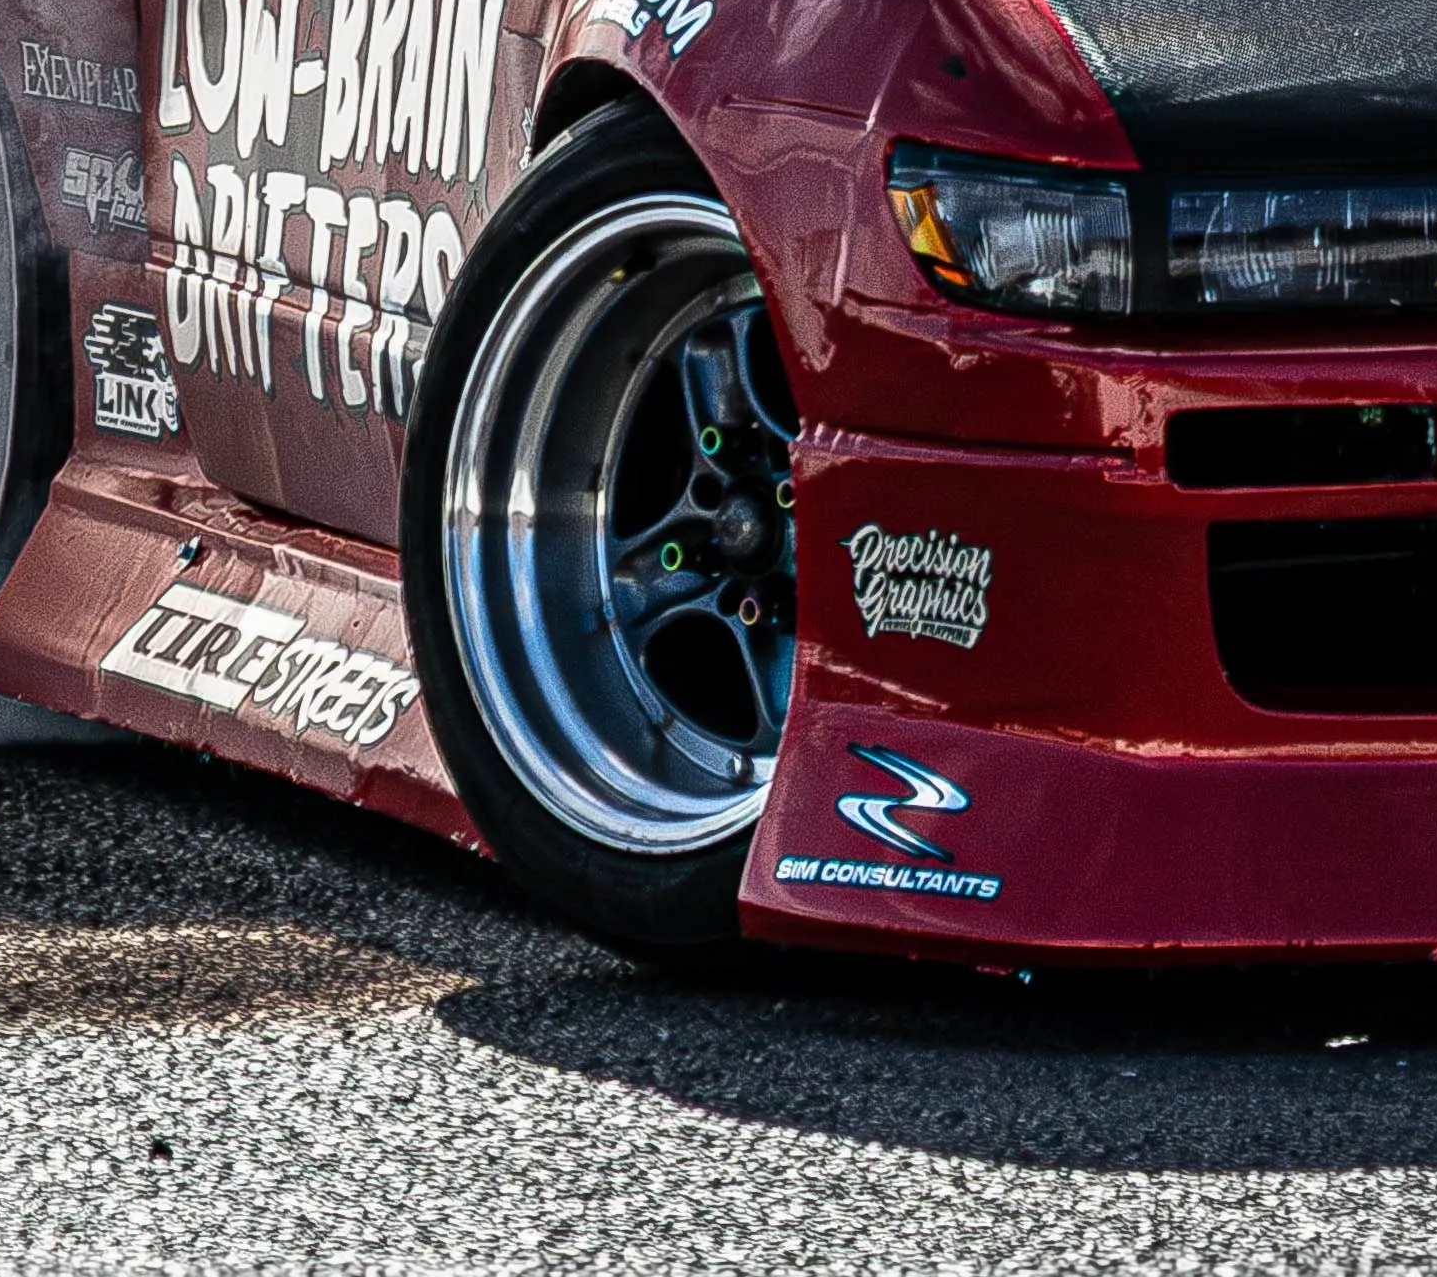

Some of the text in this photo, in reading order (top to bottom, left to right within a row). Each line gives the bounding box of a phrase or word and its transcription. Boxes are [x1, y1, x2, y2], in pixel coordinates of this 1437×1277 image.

[20, 41, 142, 113] EXEMPLAR
[167, 158, 465, 419] DRIFTERS
[97, 378, 159, 423] LINK
[839, 524, 992, 590] Precision
[853, 571, 987, 639] Graphics
[775, 856, 1000, 899] SIM CONSULTANTS
